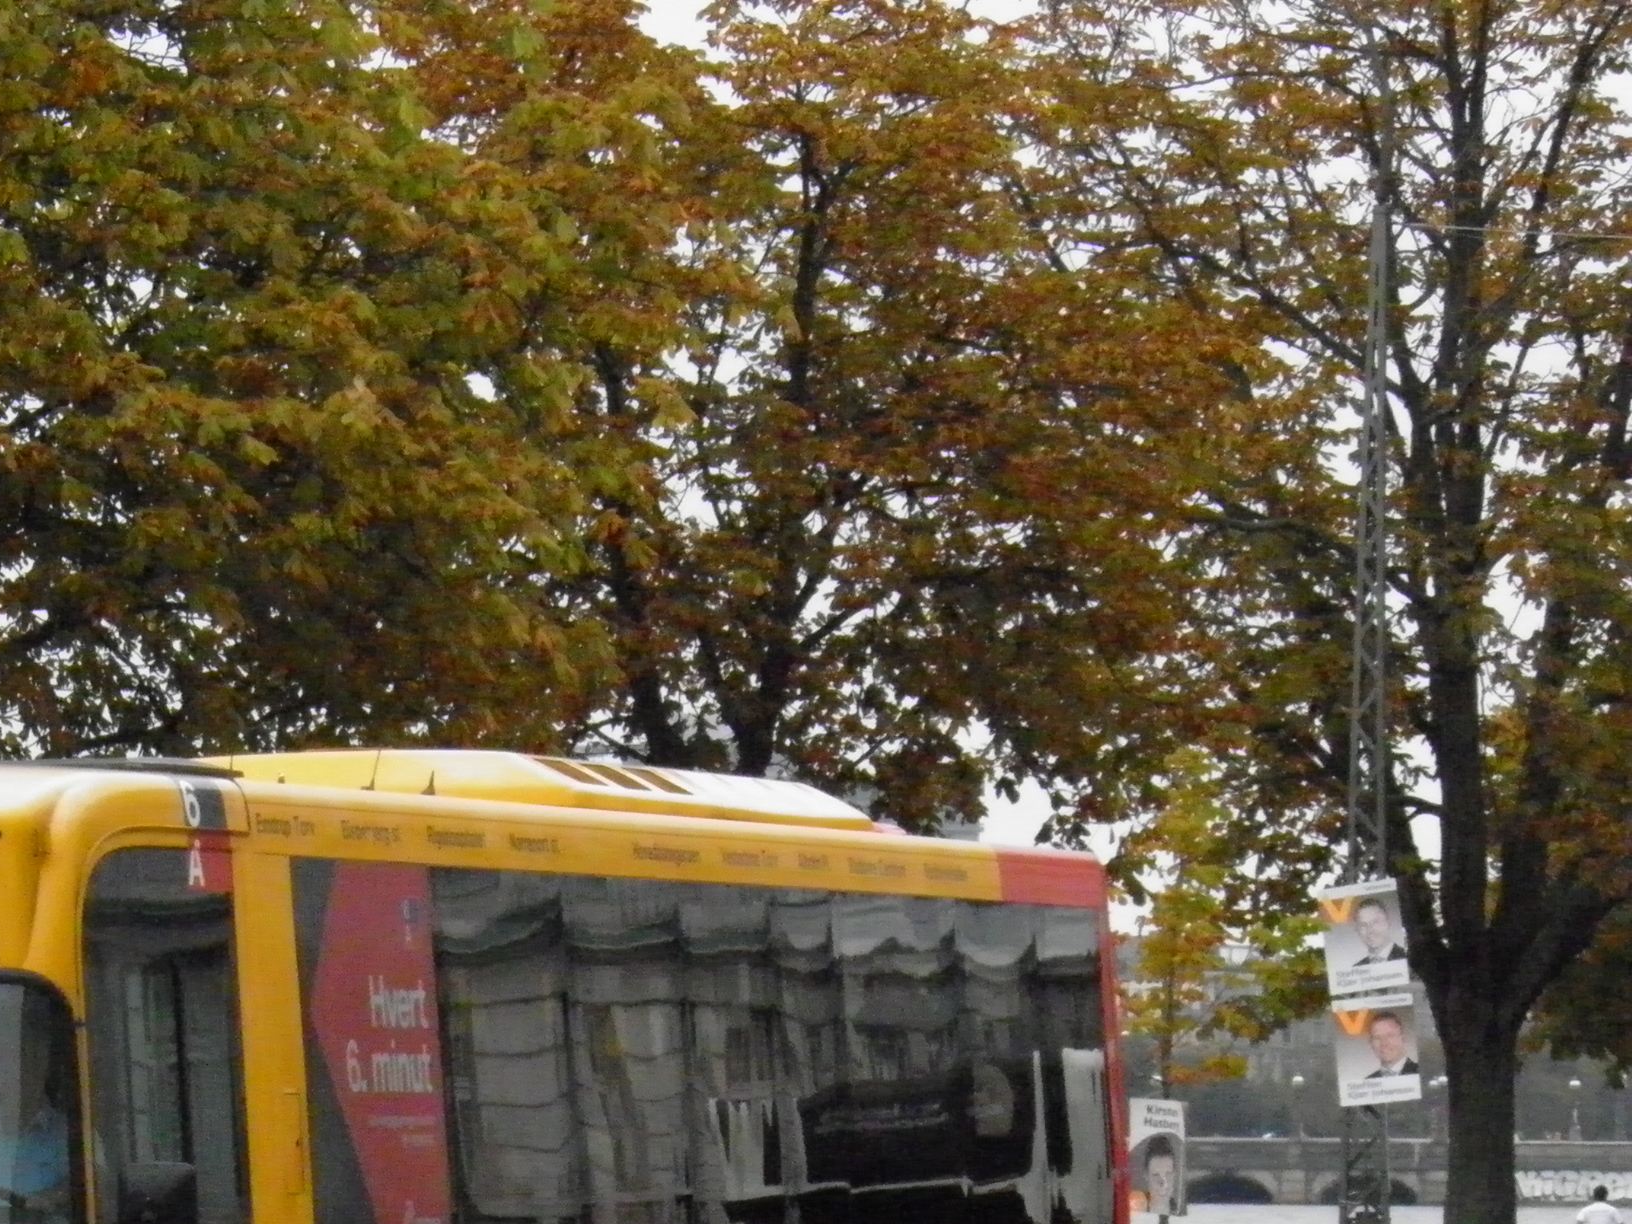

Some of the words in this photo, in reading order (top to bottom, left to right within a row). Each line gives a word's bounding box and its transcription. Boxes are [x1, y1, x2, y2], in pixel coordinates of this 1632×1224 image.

[179, 780, 201, 828] 6
[189, 839, 205, 887] A
[368, 974, 430, 1030] Hvert
[371, 1038, 435, 1094] minut
